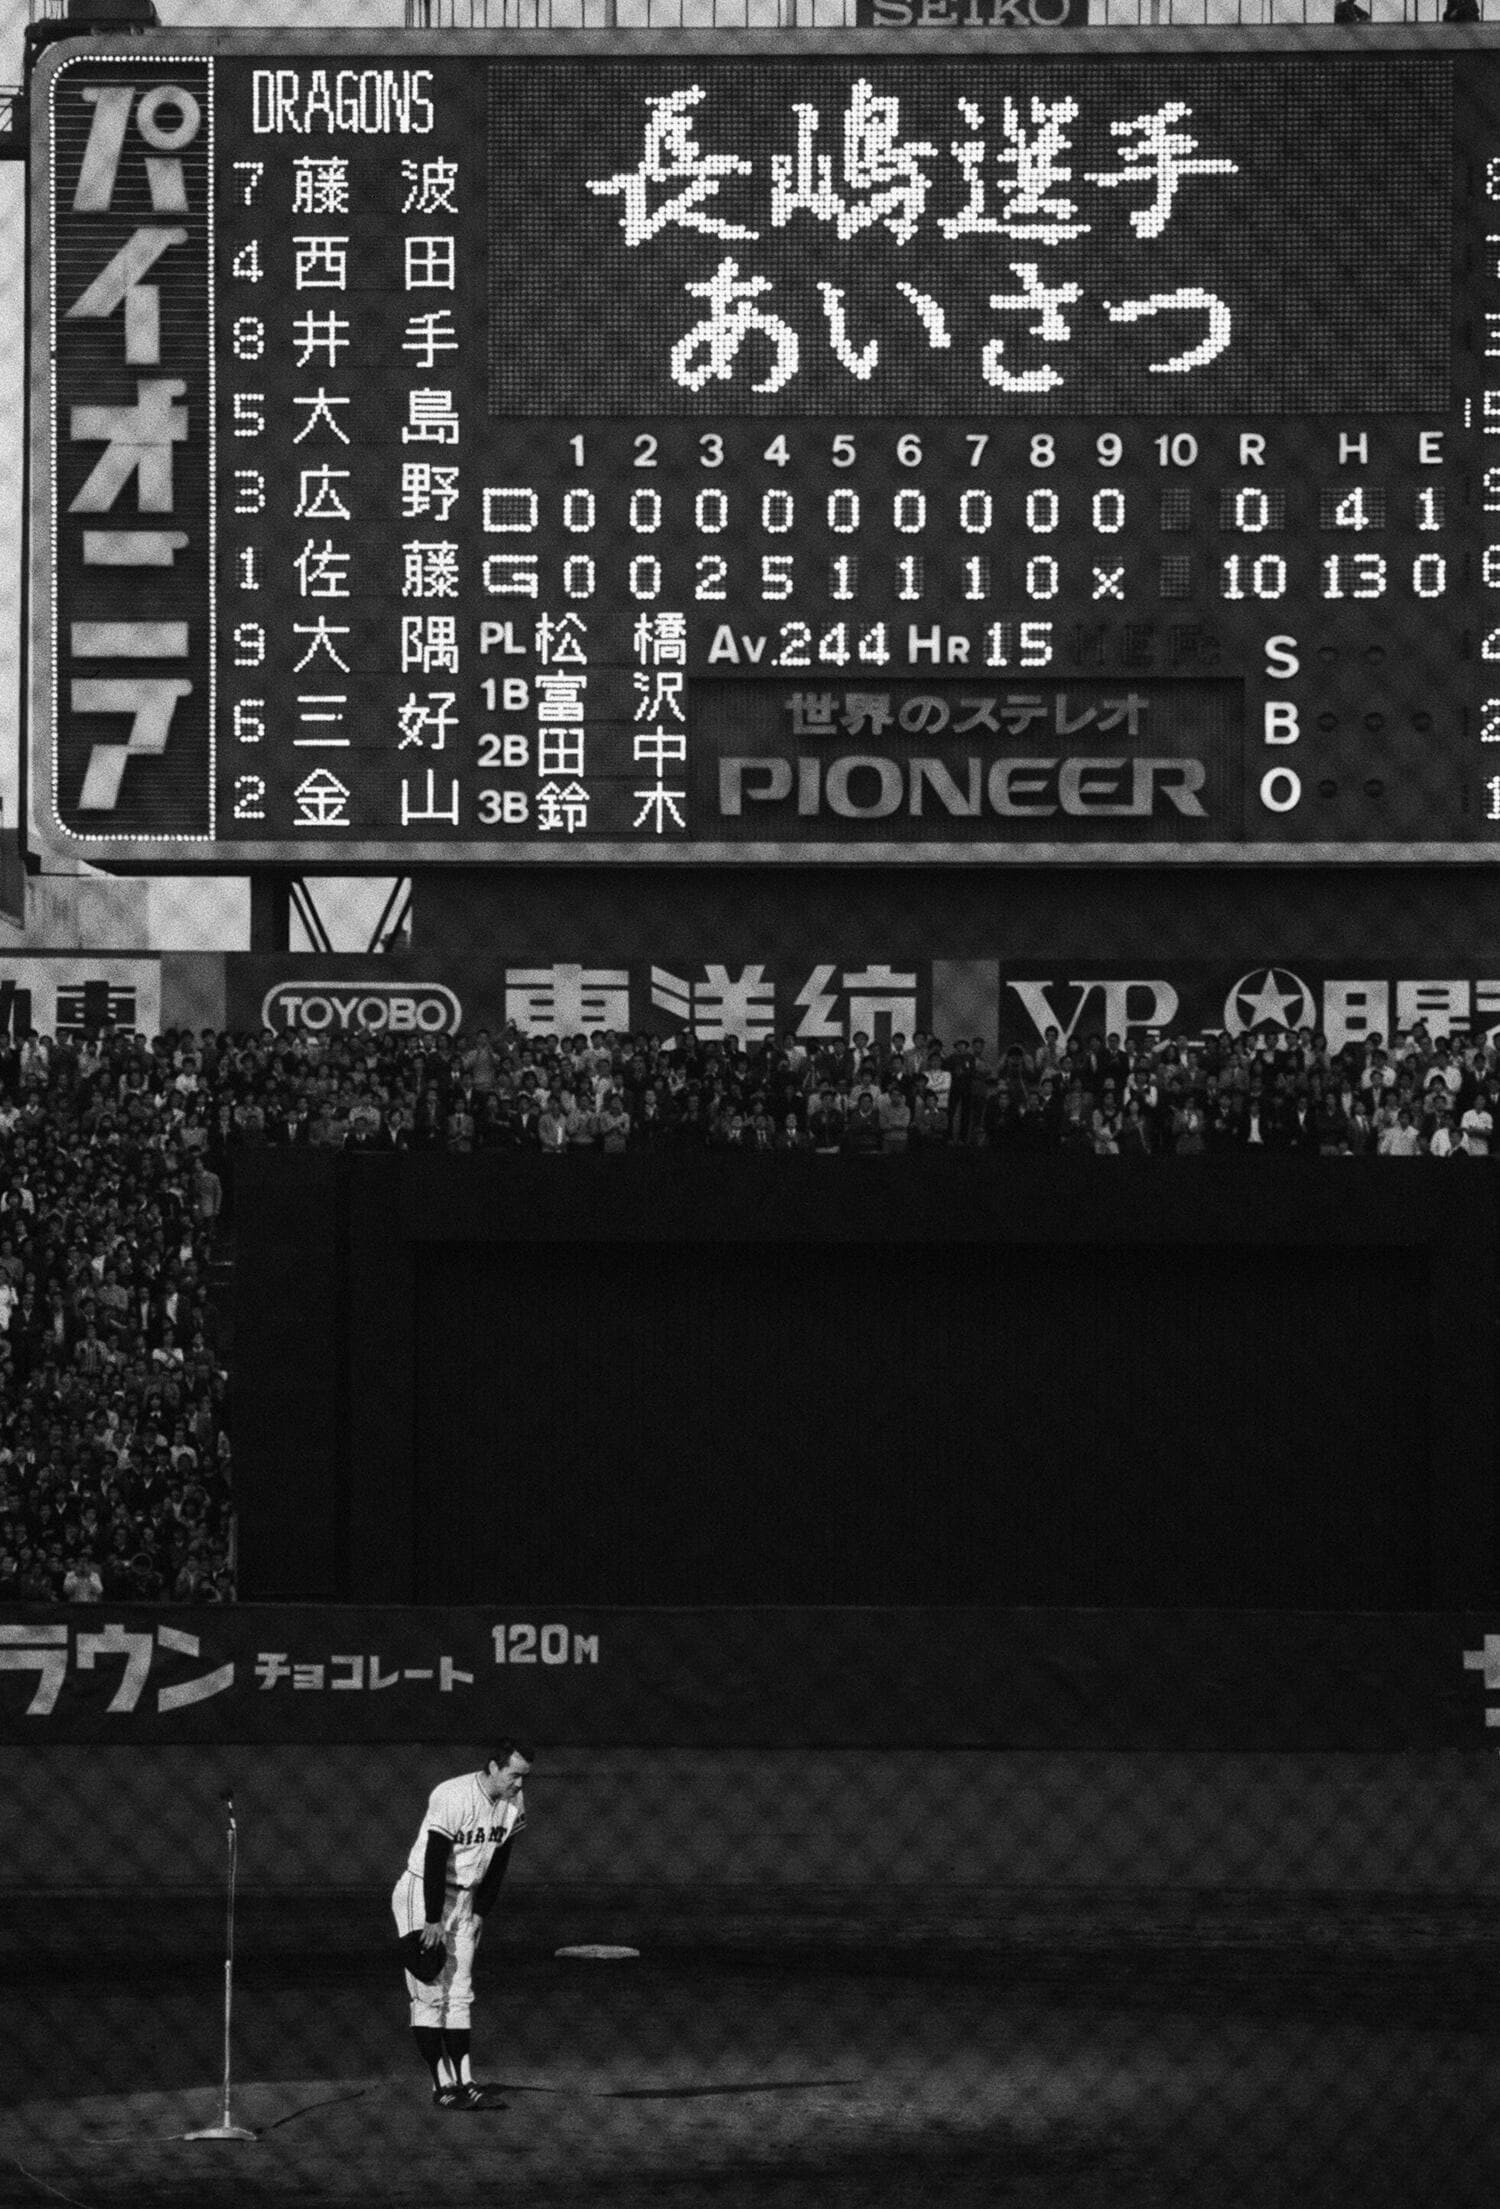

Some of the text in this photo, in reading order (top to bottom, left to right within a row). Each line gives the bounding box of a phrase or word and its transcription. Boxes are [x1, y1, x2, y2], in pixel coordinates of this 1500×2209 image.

[872, 0, 1071, 27] SEIKO
[253, 70, 433, 133] DRAGONS
[233, 162, 263, 205] 7
[233, 240, 263, 282] 4
[233, 317, 264, 360] 8
[671, 257, 1231, 393] あいさつ
[234, 394, 264, 436] 5
[64, 85, 201, 810] パイオニア
[570, 432, 1443, 467] 1 2 3 4 5 6 7 8 9 10 R H E
[235, 470, 265, 513] 3
[564, 489, 595, 532] 0
[630, 489, 661, 533] 0
[696, 489, 727, 533] 0
[762, 489, 793, 533] 0
[828, 489, 859, 533] 0
[894, 489, 926, 533] 0
[960, 490, 992, 533] 0
[1027, 489, 1058, 533] 0
[1093, 489, 1124, 533] 0
[1236, 488, 1269, 532] 0
[1336, 487, 1369, 530] 4
[1419, 488, 1440, 530] 1
[240, 547, 259, 589] 1
[483, 555, 538, 598] G
[564, 555, 595, 598] 0
[630, 555, 661, 599] 0
[695, 555, 727, 600] 2
[762, 556, 793, 600] 5
[833, 556, 853, 600] 1
[899, 556, 919, 599] 1
[966, 556, 985, 599] 1
[1027, 556, 1058, 599] 0
[1224, 555, 1286, 599] 10
[1324, 554, 1386, 598] 13
[1413, 554, 1446, 597] 0
[234, 622, 265, 666] 9
[481, 622, 526, 653] PL
[987, 622, 1052, 666] 15
[1265, 636, 1299, 678] S
[481, 678, 528, 710] 1B
[785, 692, 1149, 735] 世界のステレオ
[234, 699, 265, 742] 6
[1265, 702, 1299, 744] B
[478, 733, 528, 766] 2B
[234, 776, 265, 818] 2
[479, 790, 528, 823] 3B
[719, 755, 1207, 817] PIONEER
[278, 996, 448, 1030] TOYOBO
[505, 964, 918, 1048] 東洋紡
[1006, 980, 1179, 1050] VP
[0, 1624, 475, 1716] ラウン チョコレート
